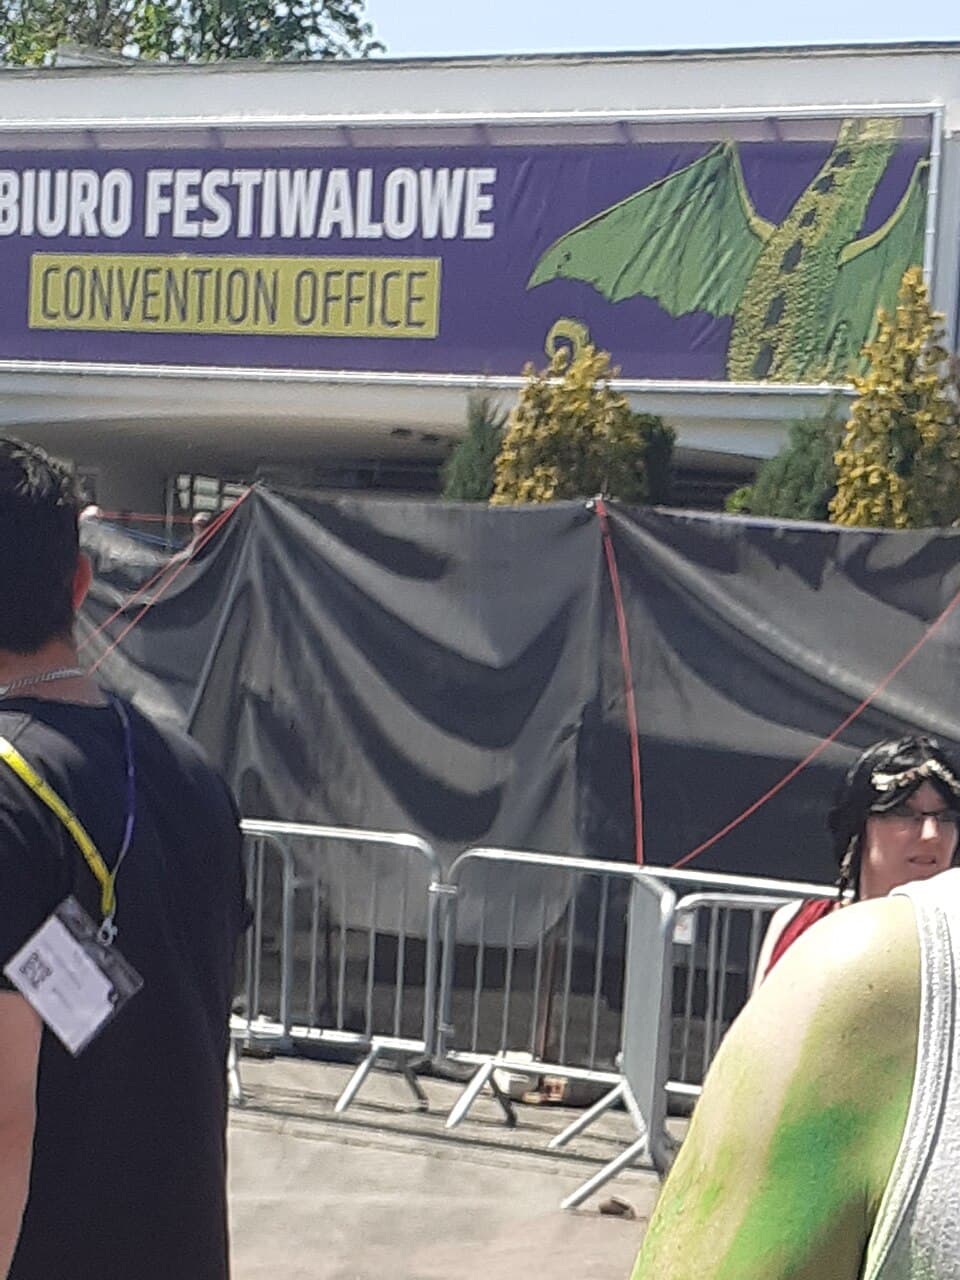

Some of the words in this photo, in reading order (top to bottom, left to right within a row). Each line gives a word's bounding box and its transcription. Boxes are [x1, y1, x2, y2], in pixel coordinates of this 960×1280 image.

[0, 168, 133, 238] BIURO
[144, 167, 497, 239] FESTIWALOWE
[42, 265, 279, 326] CONVENTION
[294, 267, 429, 328] OFFICE
